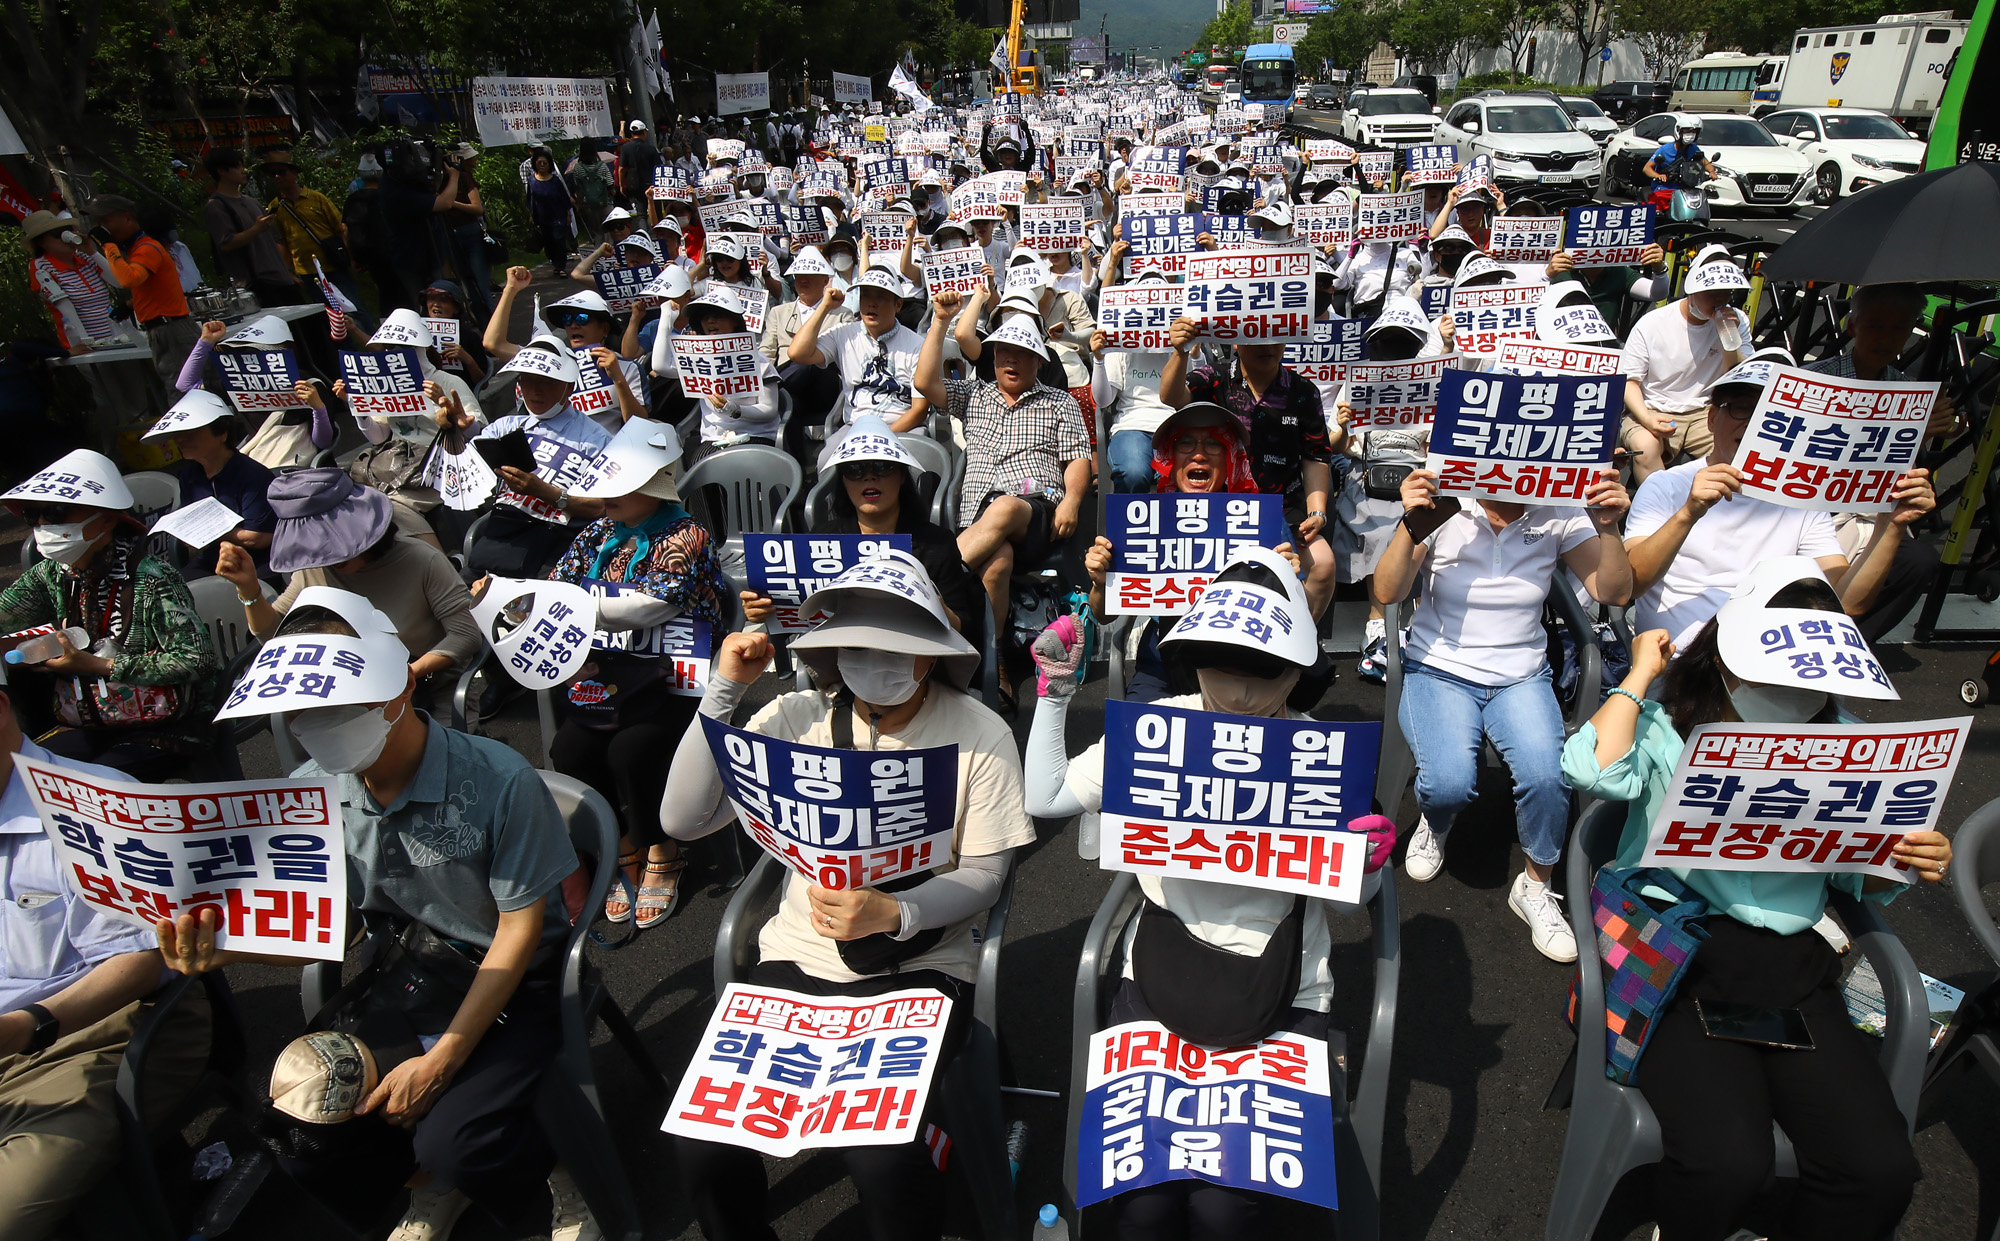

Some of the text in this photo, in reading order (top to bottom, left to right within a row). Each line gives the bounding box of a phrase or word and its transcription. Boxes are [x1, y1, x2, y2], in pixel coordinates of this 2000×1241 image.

[1258, 61, 1280, 70] 406
[738, 155, 765, 167] 국제기준
[739, 165, 767, 173] 준수하라!
[1256, 155, 1282, 164] 국제기준
[1412, 157, 1453, 171] 국제기준
[654, 176, 687, 187] 국제기준
[804, 180, 834, 188] 국제기준
[869, 172, 904, 187] 국제기준
[1131, 173, 1180, 187] 준수하라!
[1411, 169, 1455, 183] 준수하라!
[653, 188, 690, 199] 준수하라!
[698, 185, 731, 197] 준수하라!
[872, 184, 907, 199] 준수하라!
[953, 192, 997, 209] 학습권을
[1362, 191, 1422, 209] 만팔천명 의대생
[1156, 196, 1182, 208] 의대생
[1327, 205, 1350, 216] 의대생
[1022, 206, 1082, 219] 만팔천명 의대생
[1362, 206, 1421, 225] 학습권을
[1023, 218, 1082, 235] 학습권을
[1298, 217, 1350, 231] 학습권을
[1360, 223, 1422, 240] 보장하라!
[1495, 220, 1559, 231] 만팔천명 의대생
[1129, 234, 1197, 255] 국제기준
[1494, 233, 1558, 247] 학습권을
[1576, 227, 1646, 246] 국제기준
[957, 248, 982, 262] 의대생
[926, 261, 983, 281] 학습권을
[1190, 253, 1309, 281] 만팔천명 의대생
[1103, 289, 1150, 307] 만팔천명
[1187, 280, 1309, 313] 학습권을
[1454, 292, 1508, 309] 만팔천명
[1508, 287, 1546, 306] 의대생
[1194, 312, 1309, 339] 보장하라!
[672, 336, 753, 354] 만팔천명 의대생
[678, 354, 756, 375] 학습권을
[1502, 345, 1565, 368] 만팔천명
[1565, 352, 1620, 375] 의대생
[227, 373, 300, 392] 국제기준
[1132, 369, 1162, 379] Par Av
[1351, 365, 1413, 383] 만팔천명
[348, 374, 416, 394] 국제기준
[684, 375, 759, 395] 보장하라!
[352, 395, 426, 413] 준수하라!
[1774, 379, 1932, 420] 만팔천명 의대생
[1452, 419, 1603, 461] 국제기준
[1757, 410, 1918, 465] 학습권을
[840, 443, 902, 459] 정상화
[510, 600, 574, 674] 의학교육
[1176, 610, 1274, 645] 정상화
[536, 624, 588, 680] 정상화
[1788, 651, 1891, 691] 정상화
[226, 672, 337, 709] 정상화
[570, 693, 605, 703] DREAMS
[574, 683, 607, 696] SWEET
[1692, 732, 1955, 773] 만팔천명 의대생
[33, 769, 327, 832] 만팔천명 의대생
[1129, 768, 1343, 827] 국제기준
[1678, 773, 1938, 826] 학습권을
[733, 774, 928, 847] 국제기준
[51, 813, 330, 887] 학습권을
[744, 810, 932, 890] 준수하라!
[1120, 821, 1345, 888] 준수하라!
[71, 861, 332, 944] 보장하라!
[726, 994, 940, 1038] 만팔천명 의대생
[708, 1029, 929, 1089] 학습권을
[1103, 1030, 1308, 1086] 준수하라!
[678, 1076, 918, 1139] 보장하라!
[1102, 1074, 1305, 1136] 국제기준
